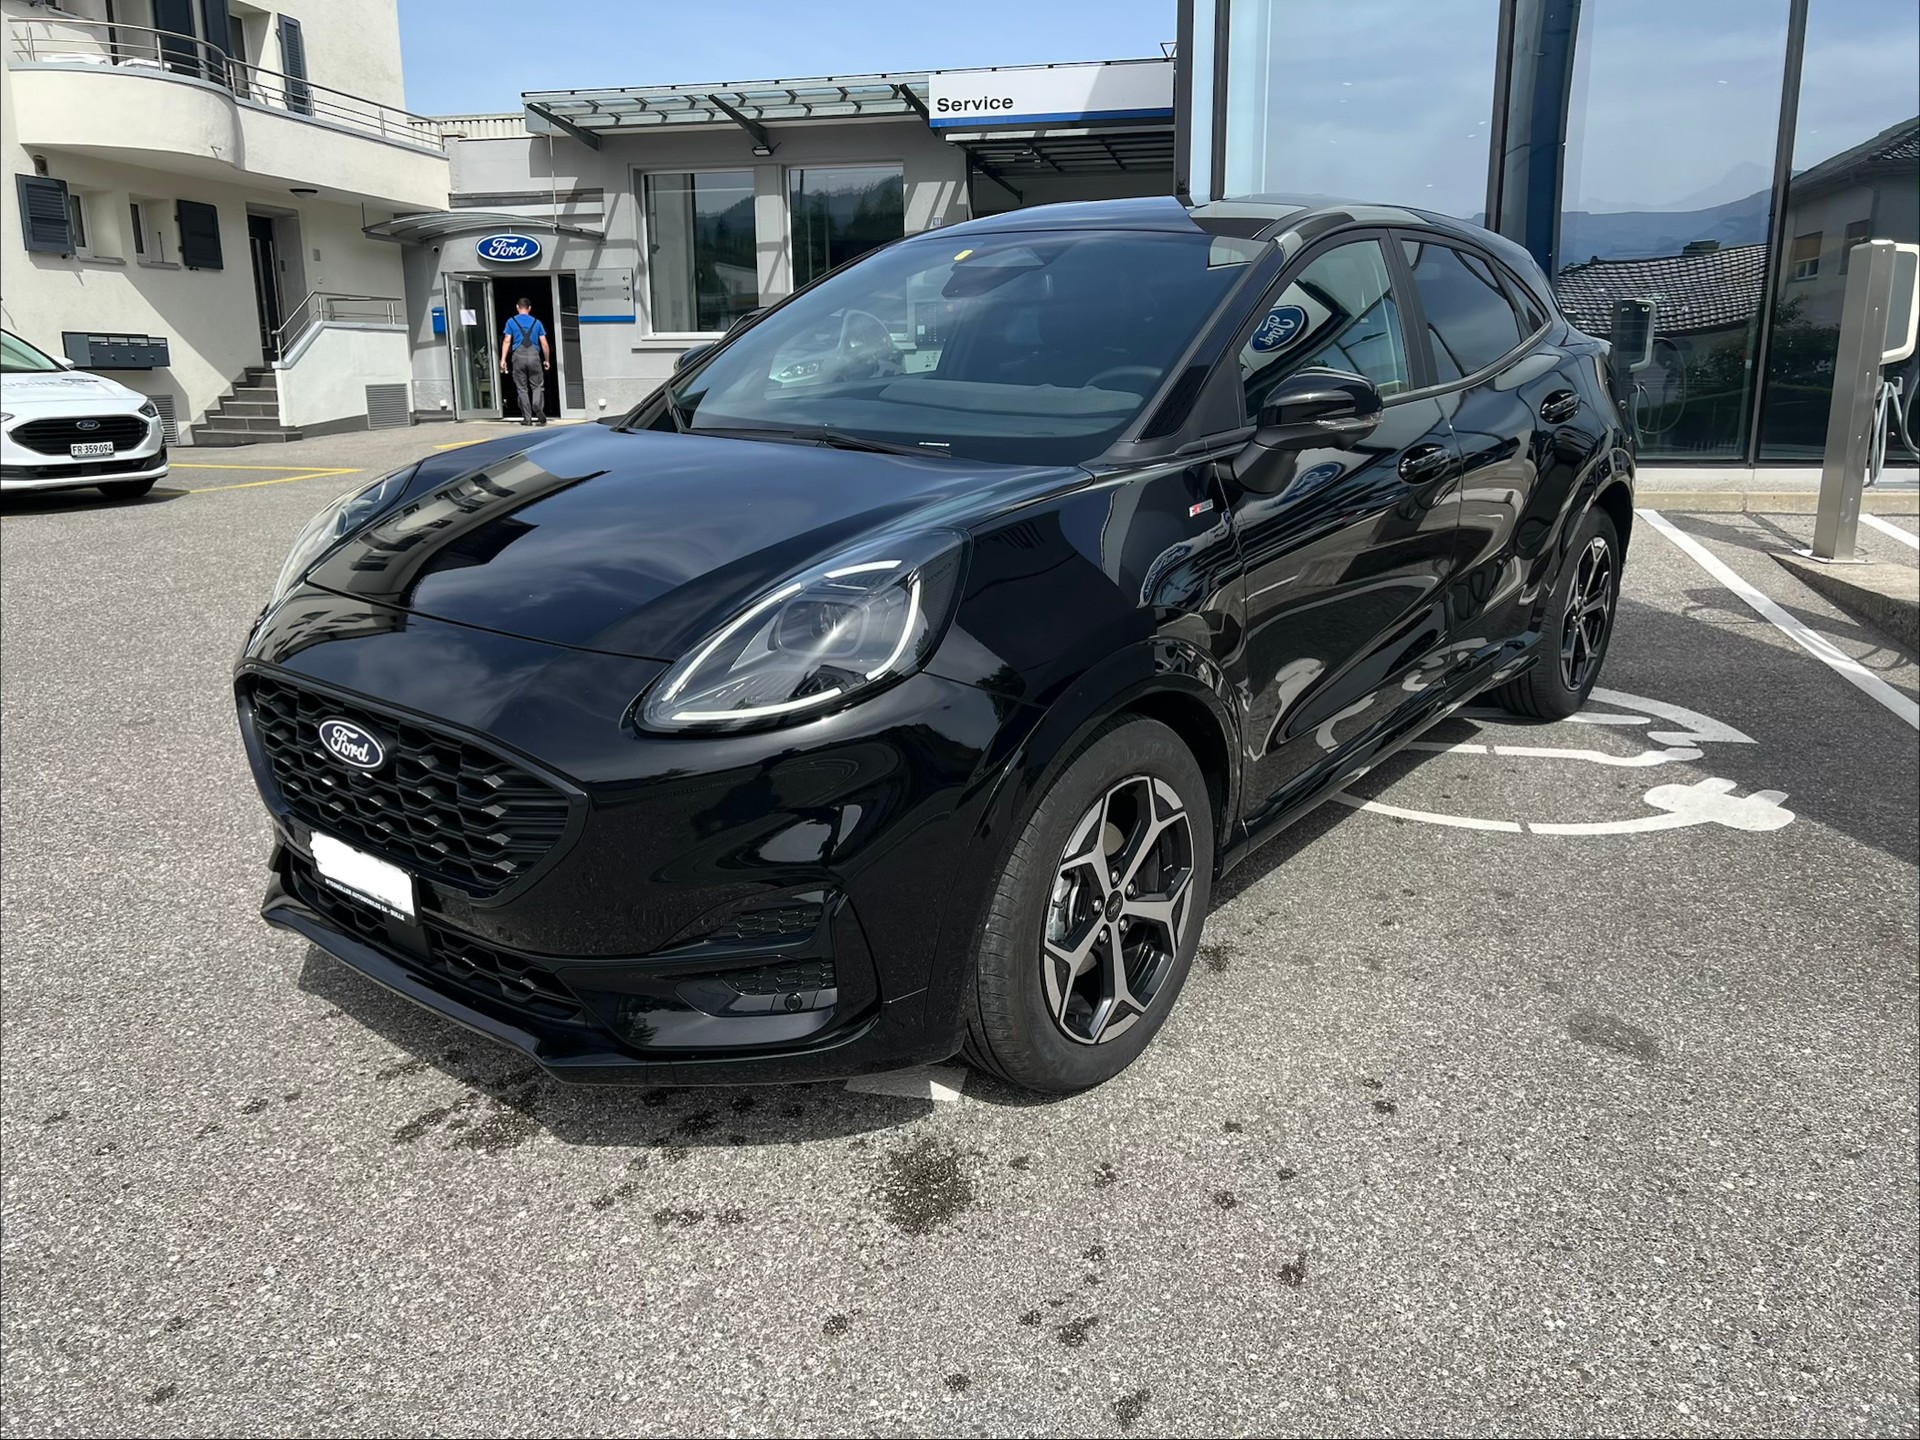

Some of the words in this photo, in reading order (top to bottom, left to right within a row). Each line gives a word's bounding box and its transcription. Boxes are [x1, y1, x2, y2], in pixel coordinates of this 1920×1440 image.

[937, 96, 1014, 112] Service
[488, 237, 528, 257] Ford
[330, 725, 370, 763] Ford
